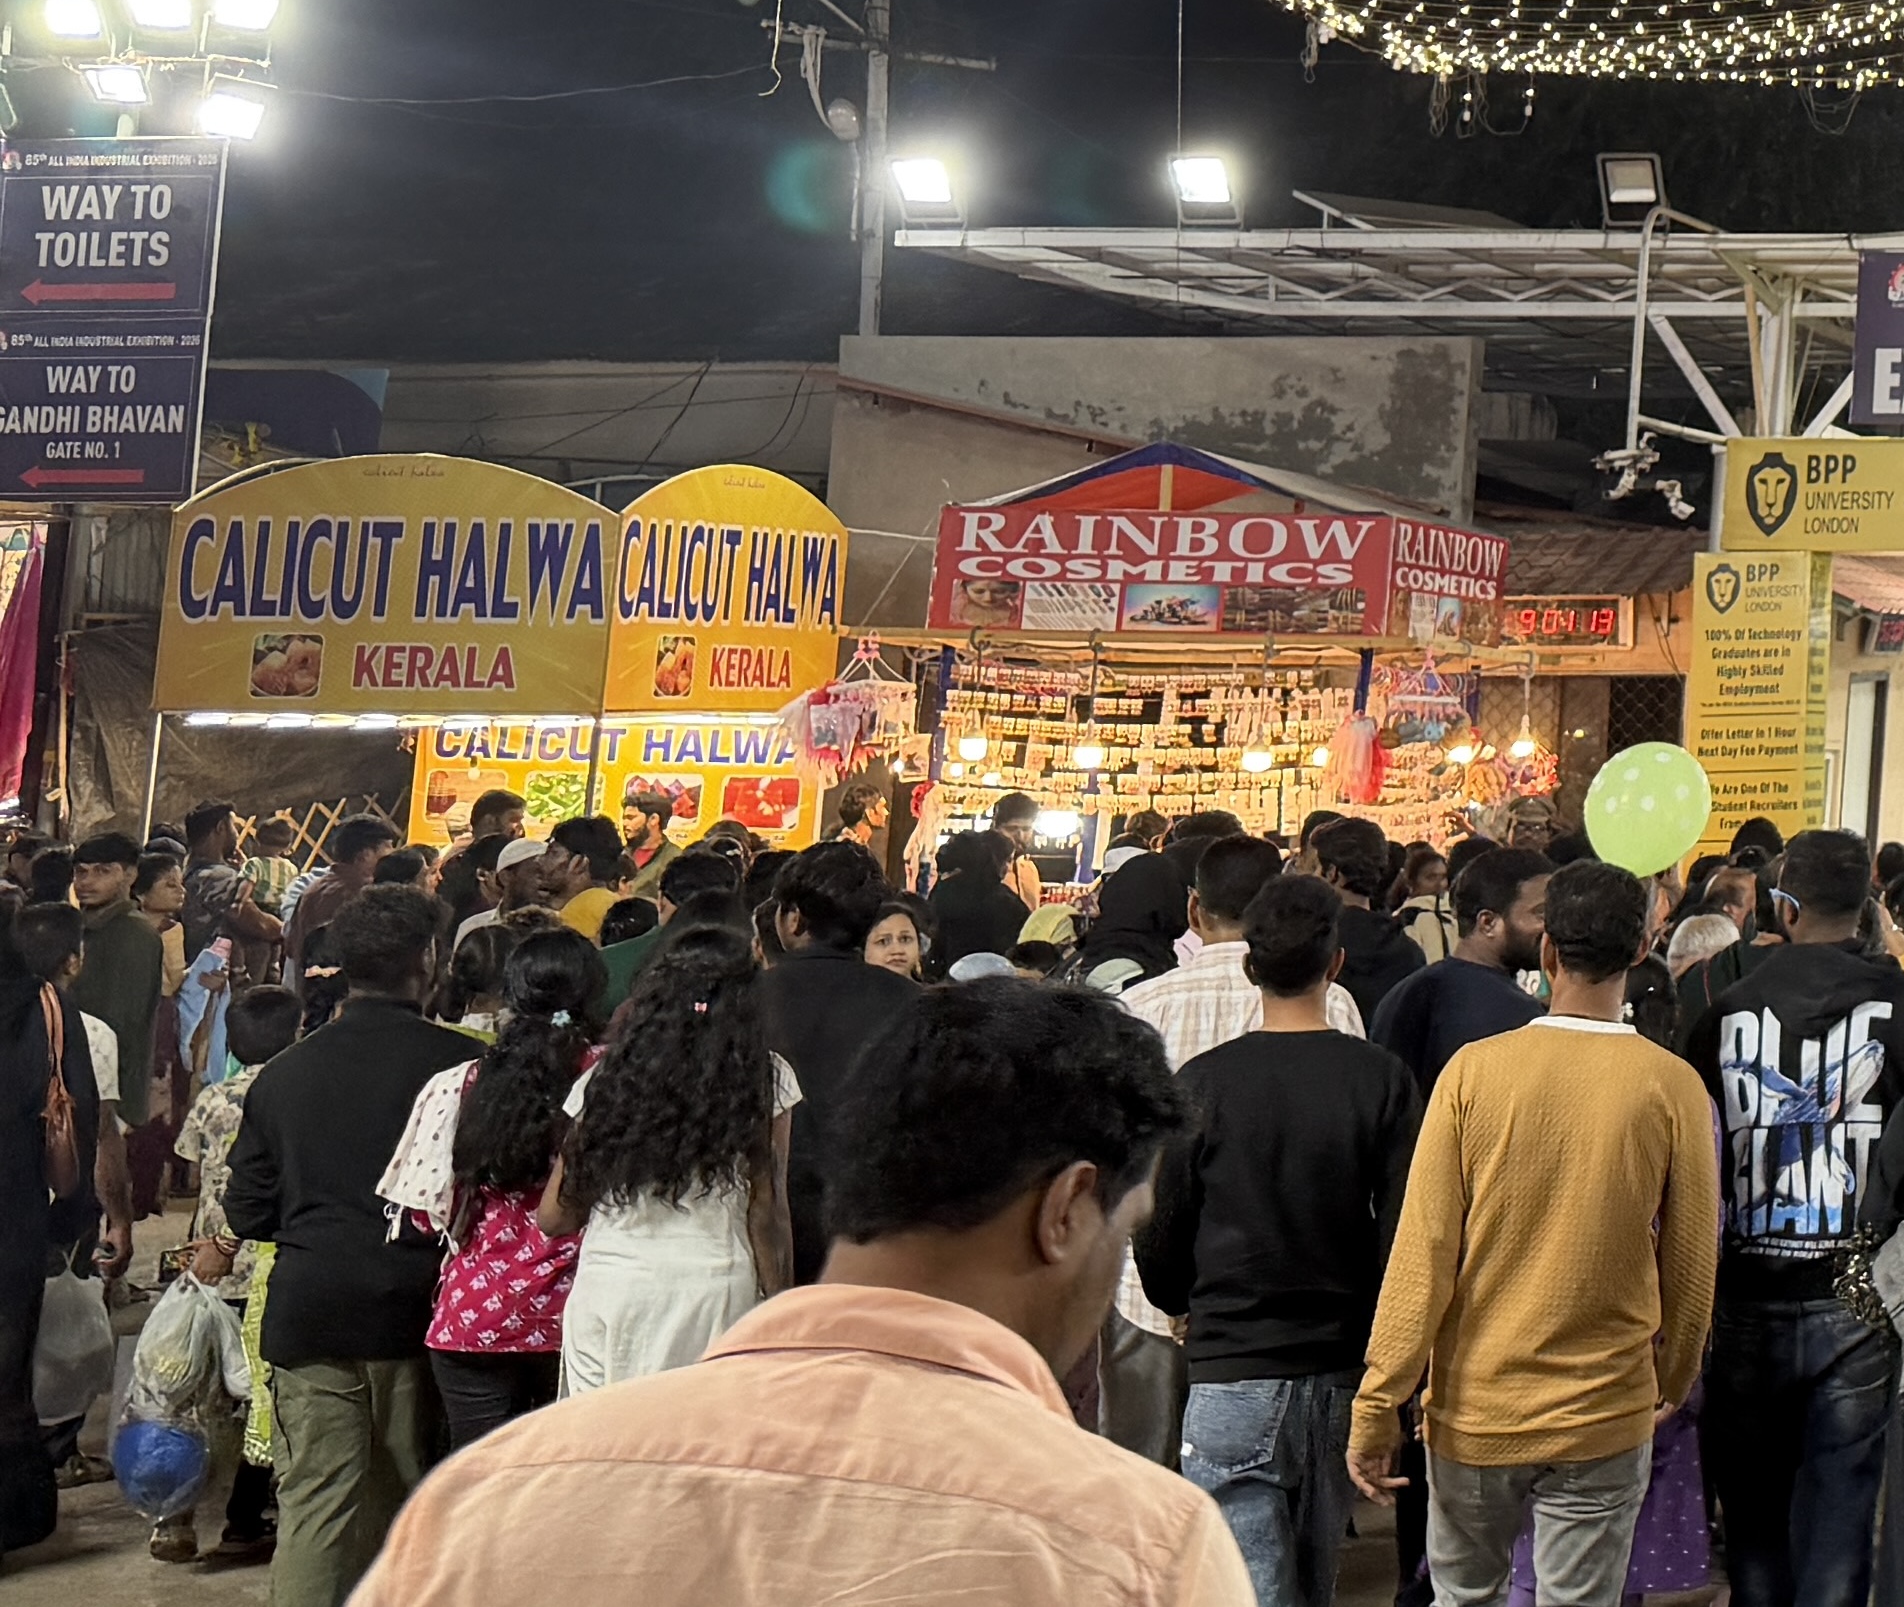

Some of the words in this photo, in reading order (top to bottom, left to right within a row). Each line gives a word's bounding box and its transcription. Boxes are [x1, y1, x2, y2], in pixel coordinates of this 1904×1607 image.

[41, 184, 123, 221] WAY
[131, 183, 172, 220] TO
[35, 231, 171, 268] TOILETS
[34, 335, 50, 347] ALL
[51, 335, 74, 347] INDIA
[75, 335, 124, 347] INDUSTRIAL
[126, 335, 175, 347] EXHIBITION
[46, 365, 102, 394] WAY
[107, 365, 136, 394] TO
[86, 404, 186, 434] BHAVAN
[46, 441, 82, 459] GATE
[85, 441, 109, 459] NO.
[113, 441, 121, 459] 1
[1806, 454, 1857, 485] BPP
[1805, 490, 1894, 511] UNIVERSITY
[954, 510, 1376, 560] RAINBOW
[1804, 515, 1860, 535] LONDON
[1395, 522, 1505, 578] RAINBOW
[179, 515, 407, 625] CALICUT
[413, 515, 606, 627] HALWA
[618, 517, 743, 627] CALICUT
[743, 523, 840, 630] HALWA
[955, 554, 1355, 586] COSMETICS
[1395, 566, 1498, 601] COSMETICS
[1746, 563, 1781, 583] BPP
[351, 642, 517, 691] KERALA
[709, 645, 792, 691] KERALA
[434, 725, 628, 763] CALICUT
